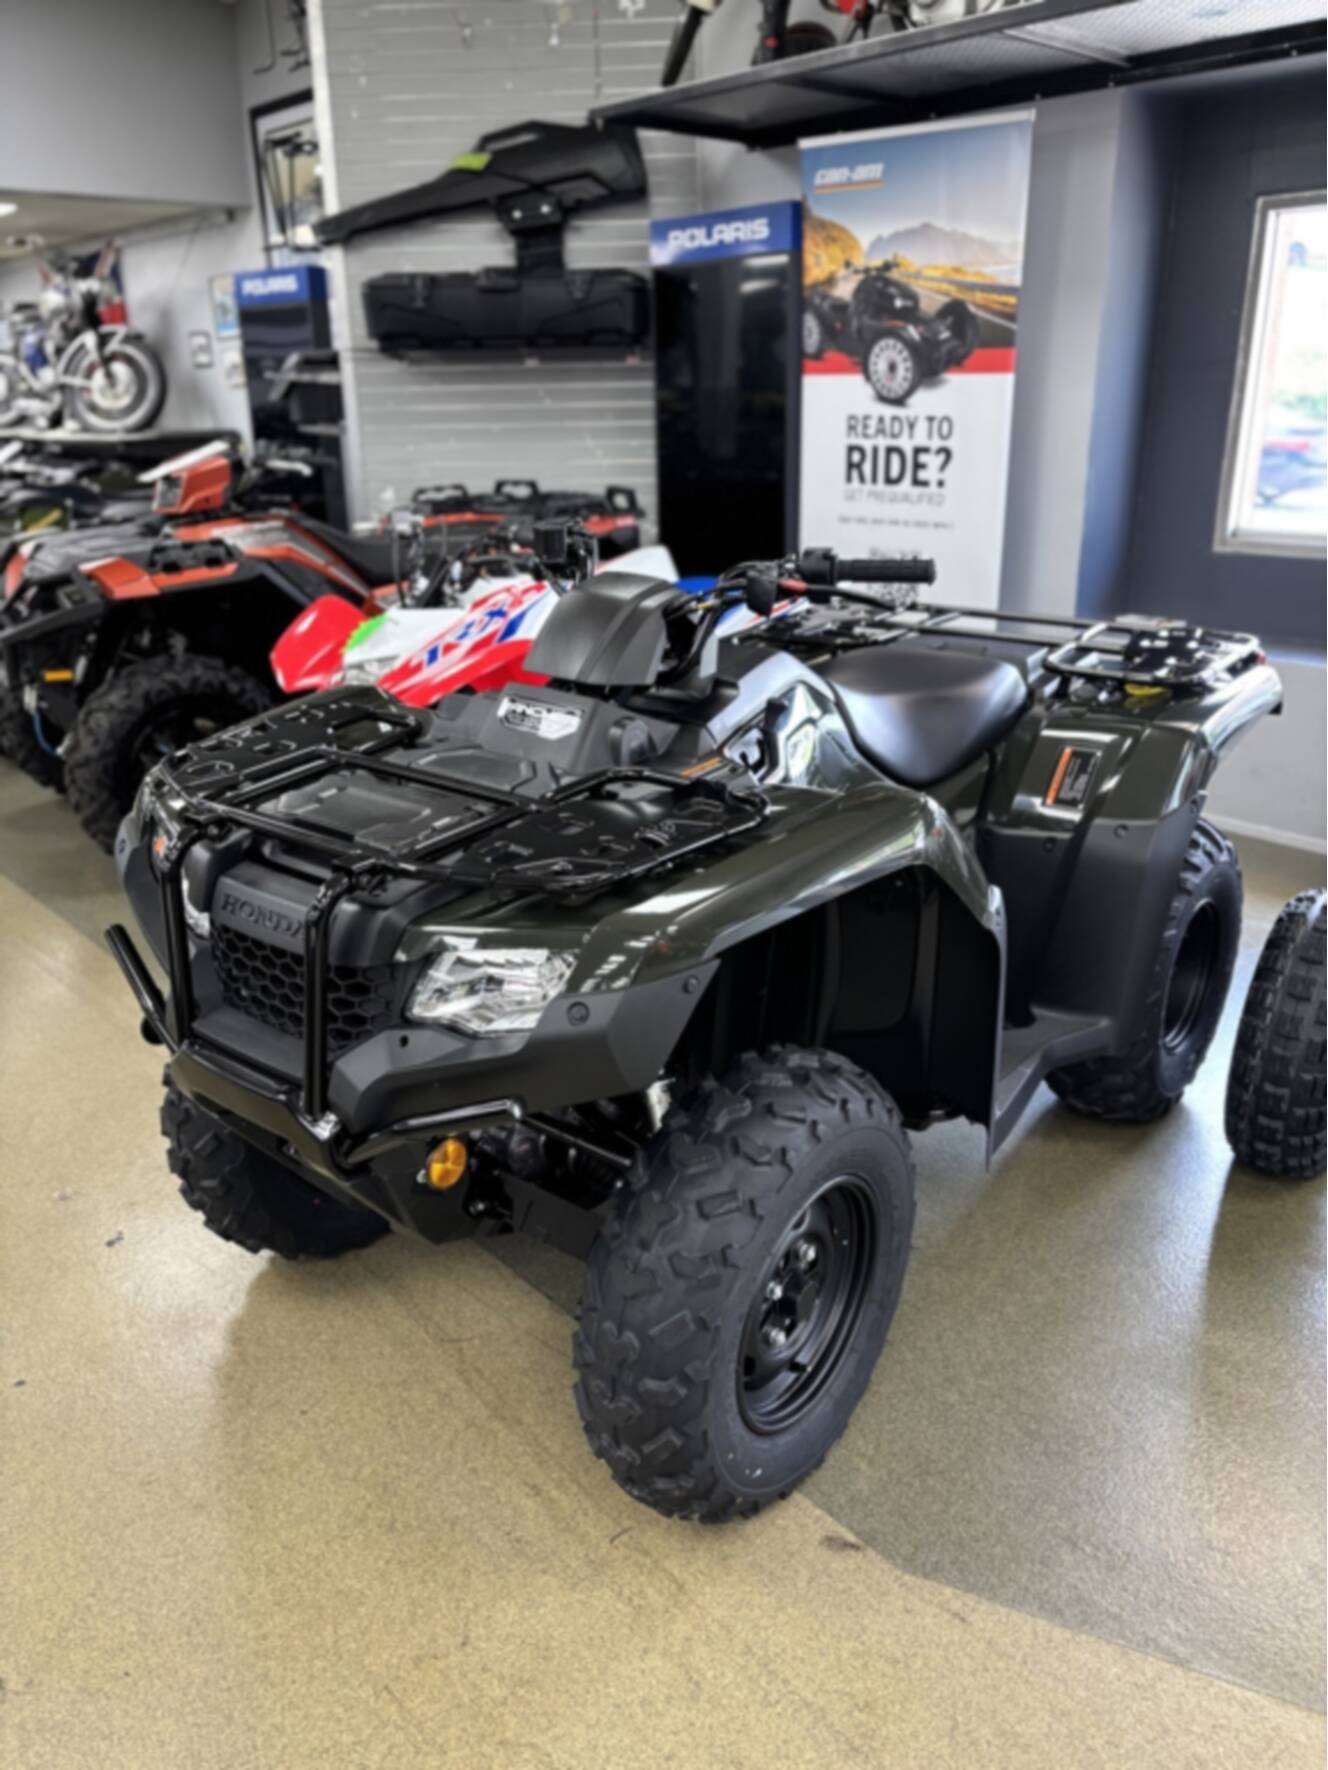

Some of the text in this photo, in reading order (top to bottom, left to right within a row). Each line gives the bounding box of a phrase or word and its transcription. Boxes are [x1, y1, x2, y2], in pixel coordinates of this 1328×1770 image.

[667, 217, 771, 250] POLARIS
[846, 414, 954, 441] READY TO
[845, 444, 953, 488] RIDE?
